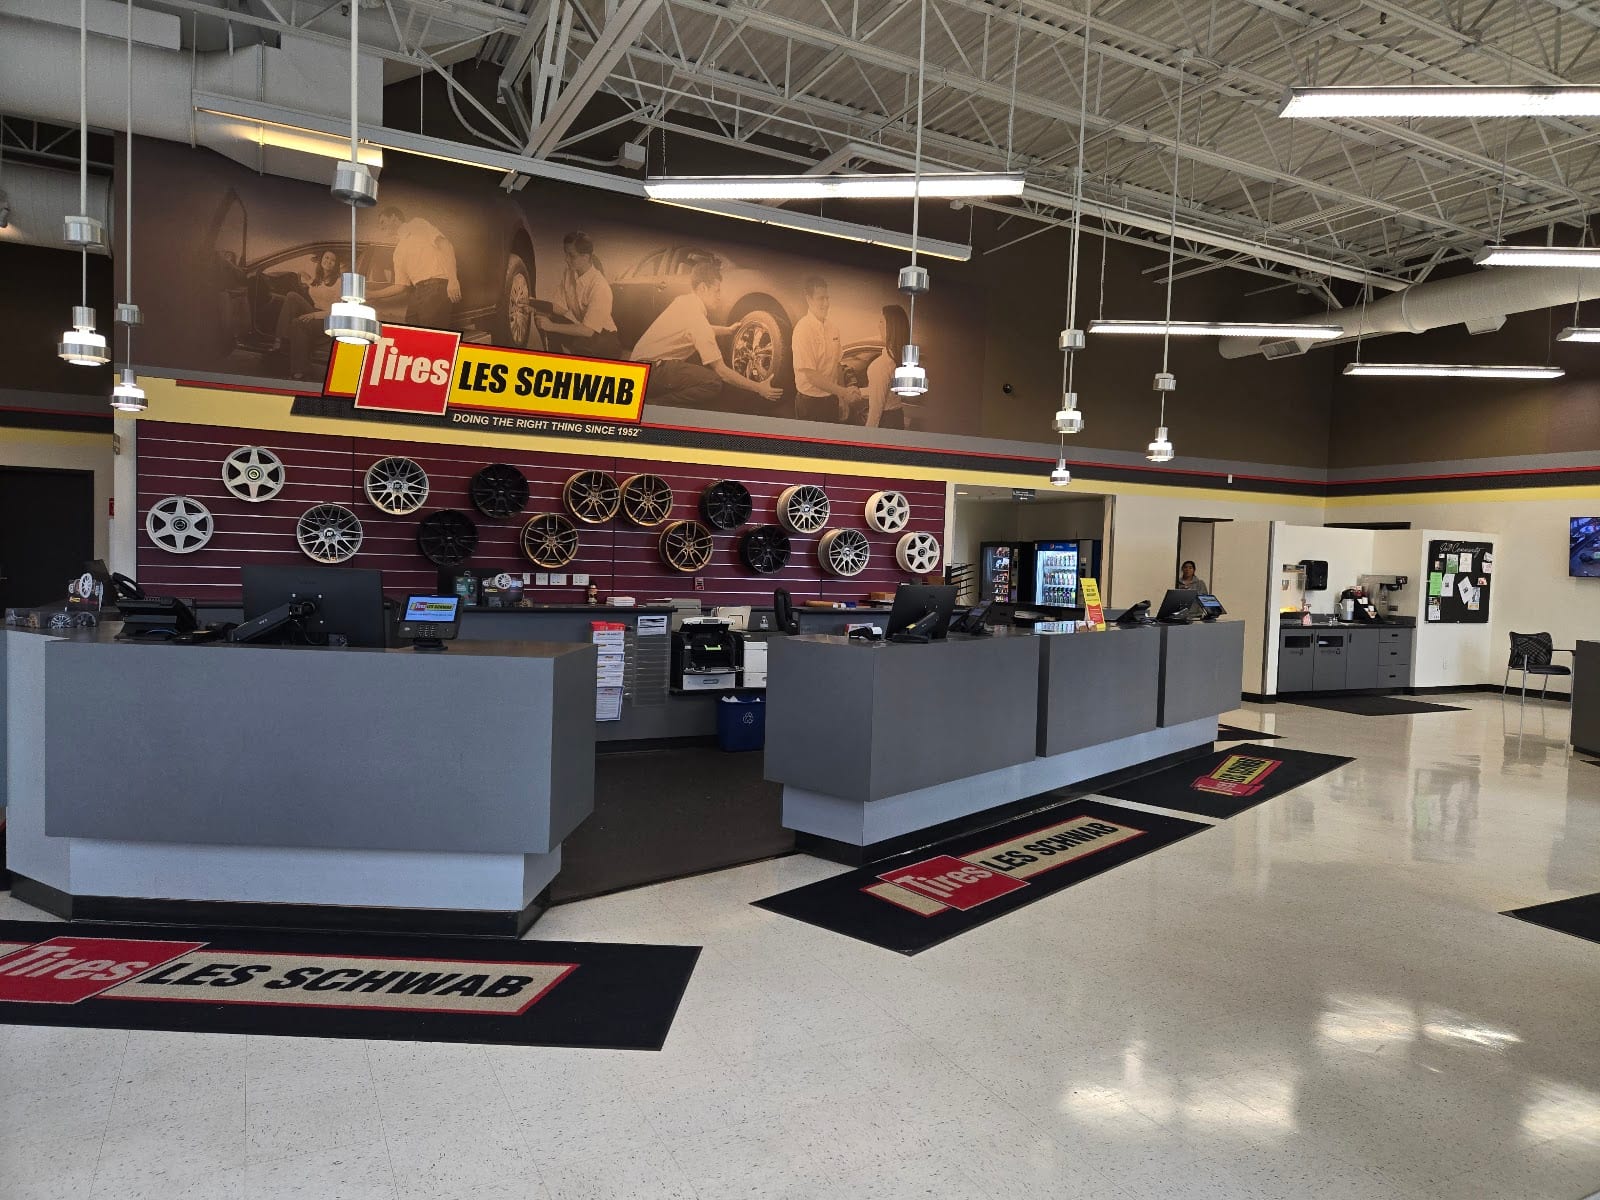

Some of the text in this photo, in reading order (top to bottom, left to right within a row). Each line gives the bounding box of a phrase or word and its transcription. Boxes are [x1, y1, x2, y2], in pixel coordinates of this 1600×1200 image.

[369, 337, 450, 386] Tires
[458, 361, 635, 406] LES SCHWAB
[453, 413, 489, 425] DOING
[492, 416, 514, 427] THE
[516, 418, 549, 430] RIGHT
[552, 421, 583, 433] THING
[585, 424, 615, 435] SINCE
[892, 822, 1119, 898] Tires LES SCHWAB
[0, 945, 534, 998] Tires LES SCHWAB
